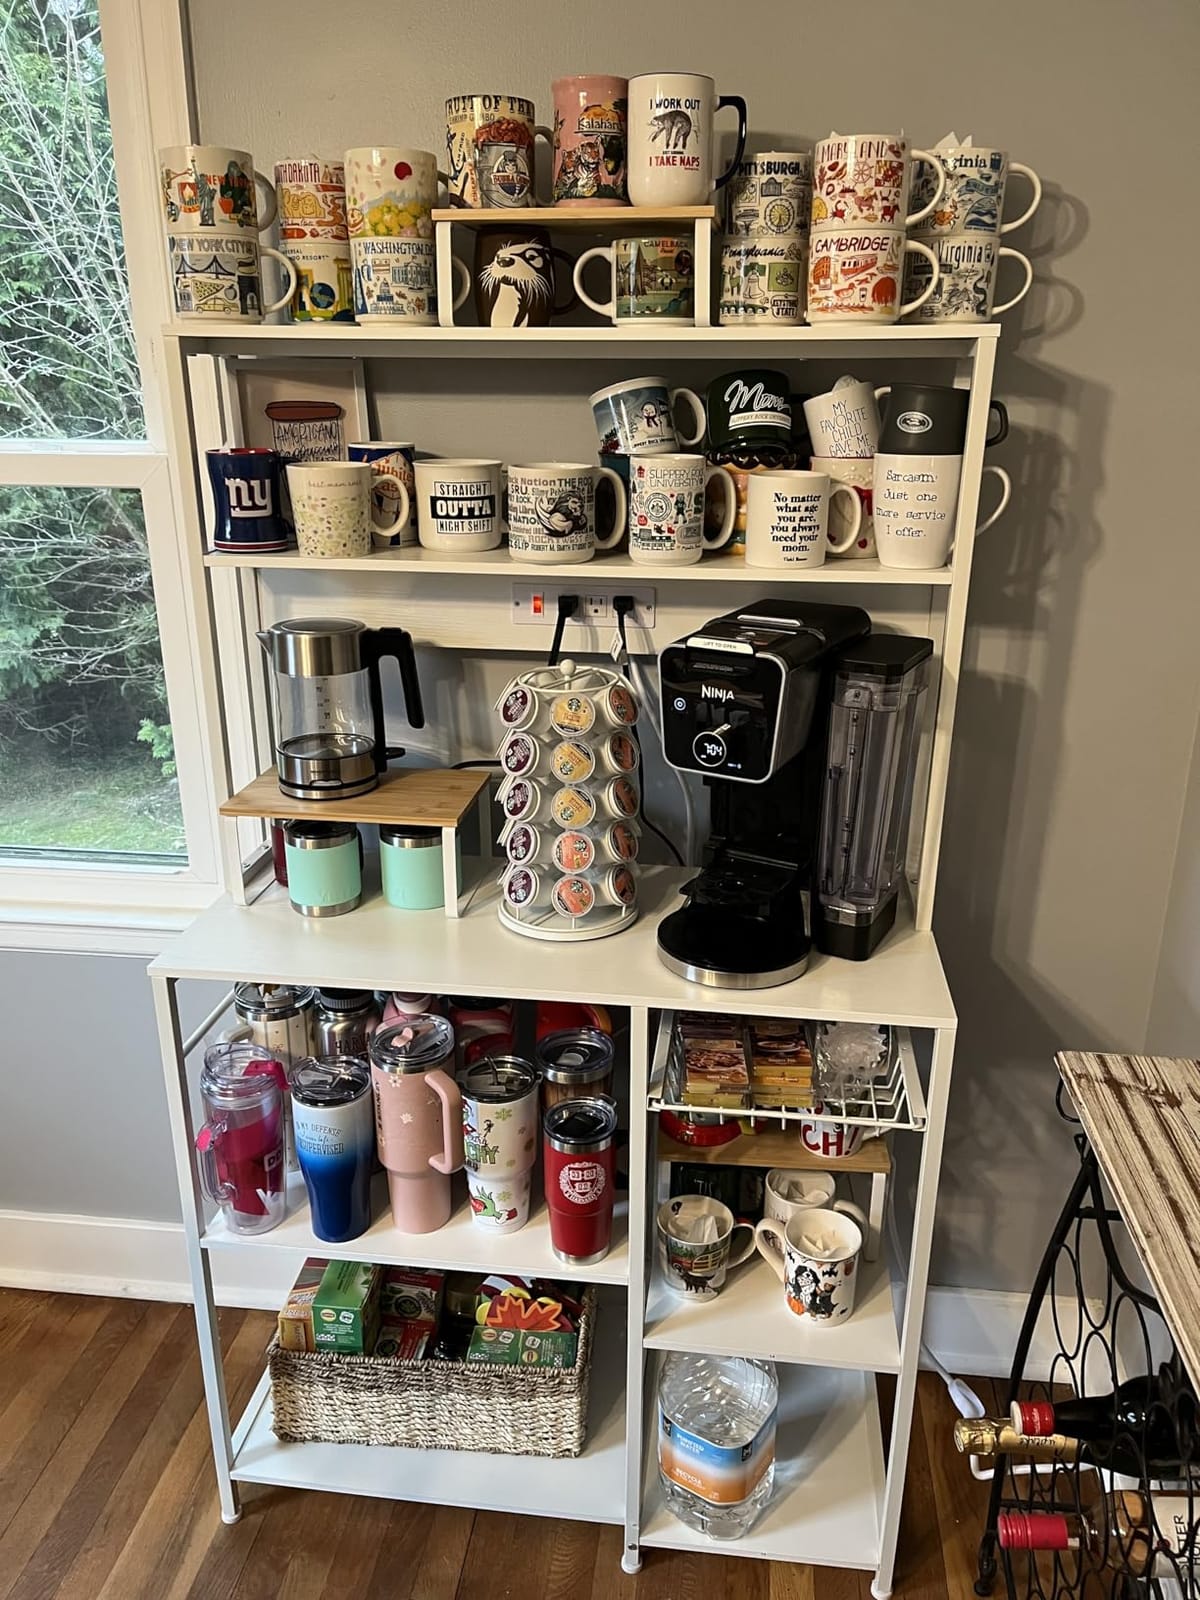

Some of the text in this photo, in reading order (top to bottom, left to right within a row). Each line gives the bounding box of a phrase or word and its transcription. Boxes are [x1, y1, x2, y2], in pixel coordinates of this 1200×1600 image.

[446, 95, 474, 115] RUIT
[482, 95, 502, 112] OF
[649, 98, 701, 111] I WORK OUT
[821, 141, 888, 163] MARYAND
[649, 156, 700, 168] I TAKE NAPS
[195, 238, 224, 253] YORK
[815, 236, 890, 253] CAMBRIDGE
[938, 240, 983, 269] Virginia
[833, 400, 847, 416] MY
[820, 407, 868, 433] FAVORITE
[832, 423, 862, 443] CHILD
[829, 434, 871, 457] GAVE ME
[649, 467, 688, 479] SLIPPERY
[521, 477, 556, 486] Nation
[557, 477, 577, 488] THE
[649, 478, 702, 488] UNIVERSITY
[439, 483, 488, 496] STRAIGHT
[883, 489, 938, 502] Just one
[773, 492, 822, 503] No matter
[436, 499, 491, 517] OUTTA
[776, 503, 819, 515] what age
[876, 507, 946, 521] more service
[439, 519, 490, 532] NIGHT SHIFT
[513, 514, 540, 525] NATIO
[777, 515, 796, 525] you
[770, 523, 820, 535] you always
[886, 524, 890, 535] I
[772, 533, 818, 544] need your
[701, 684, 735, 703] NINJA
